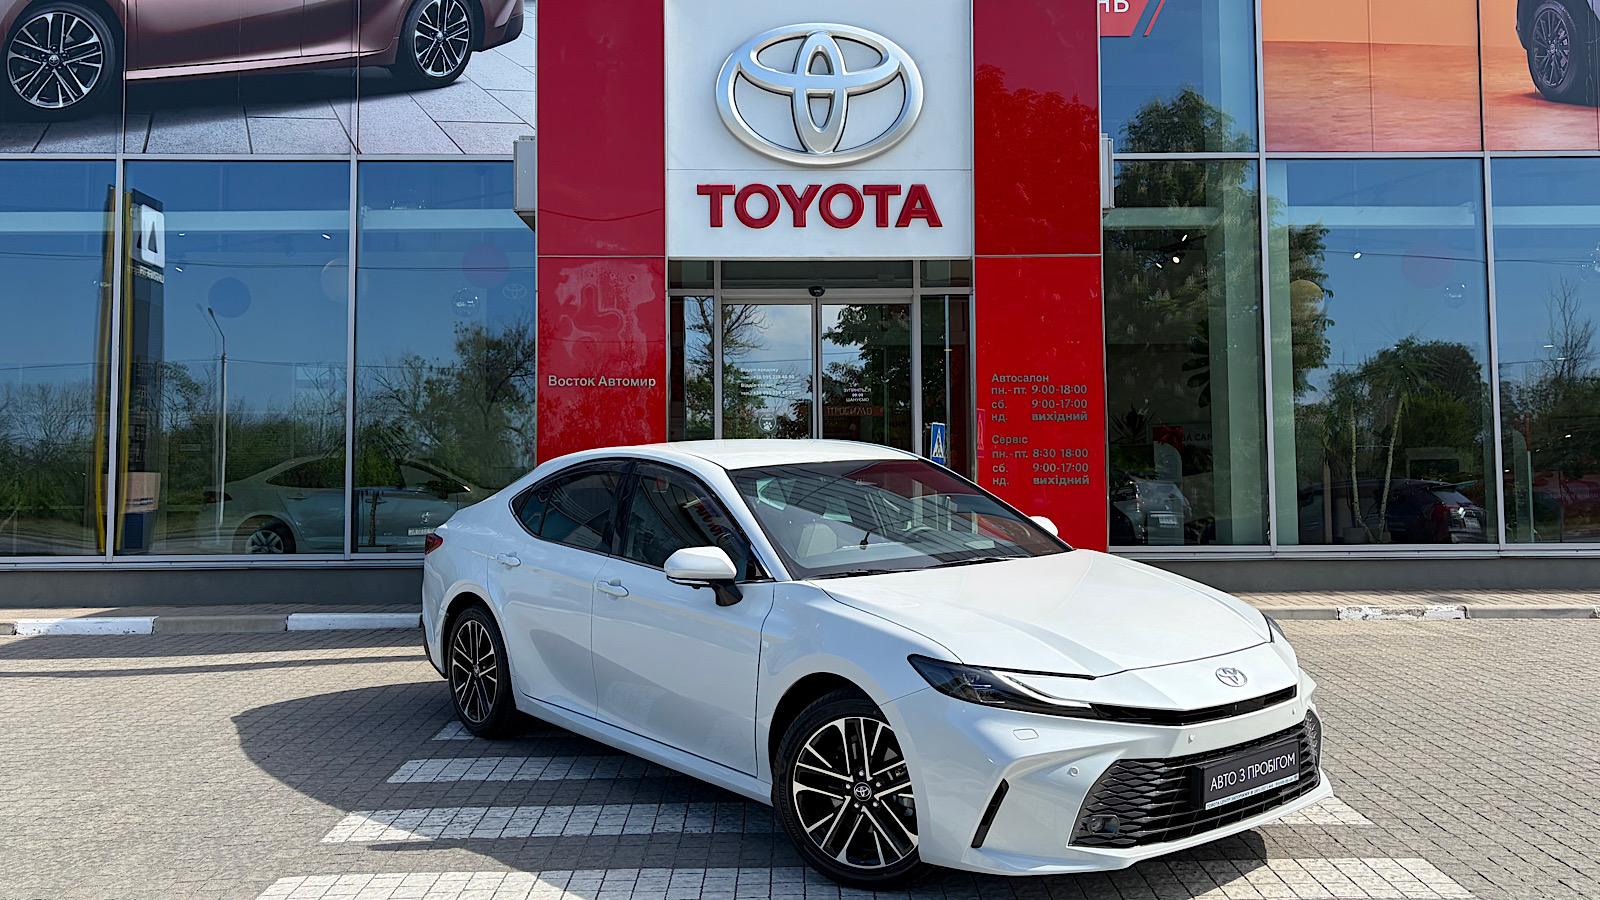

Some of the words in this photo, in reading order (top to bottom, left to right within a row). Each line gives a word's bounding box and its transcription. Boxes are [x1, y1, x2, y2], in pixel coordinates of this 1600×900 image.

[696, 182, 943, 230] TOYOTA
[548, 375, 596, 387] Восток
[598, 375, 657, 389] Автомир
[991, 373, 1050, 382] Автосалон
[1031, 385, 1088, 395] 9:00-18:00
[991, 399, 1008, 409] сб.
[1031, 399, 1088, 409] 9:00-17:00
[991, 413, 1008, 422] нд.
[1031, 411, 1088, 422] вихідний
[991, 435, 1029, 445] Сервіс
[1014, 450, 1028, 458] пт.
[1032, 448, 1056, 458] 8:30
[1060, 448, 1089, 458] 18:00
[992, 463, 1009, 473] сб.
[1032, 463, 1089, 473] 9:00-17:00
[992, 477, 1010, 486] нд.
[1033, 475, 1090, 486] вихідний
[1210, 771, 1237, 792] АВТО
[1247, 752, 1296, 780] ПРОБІГОМ
